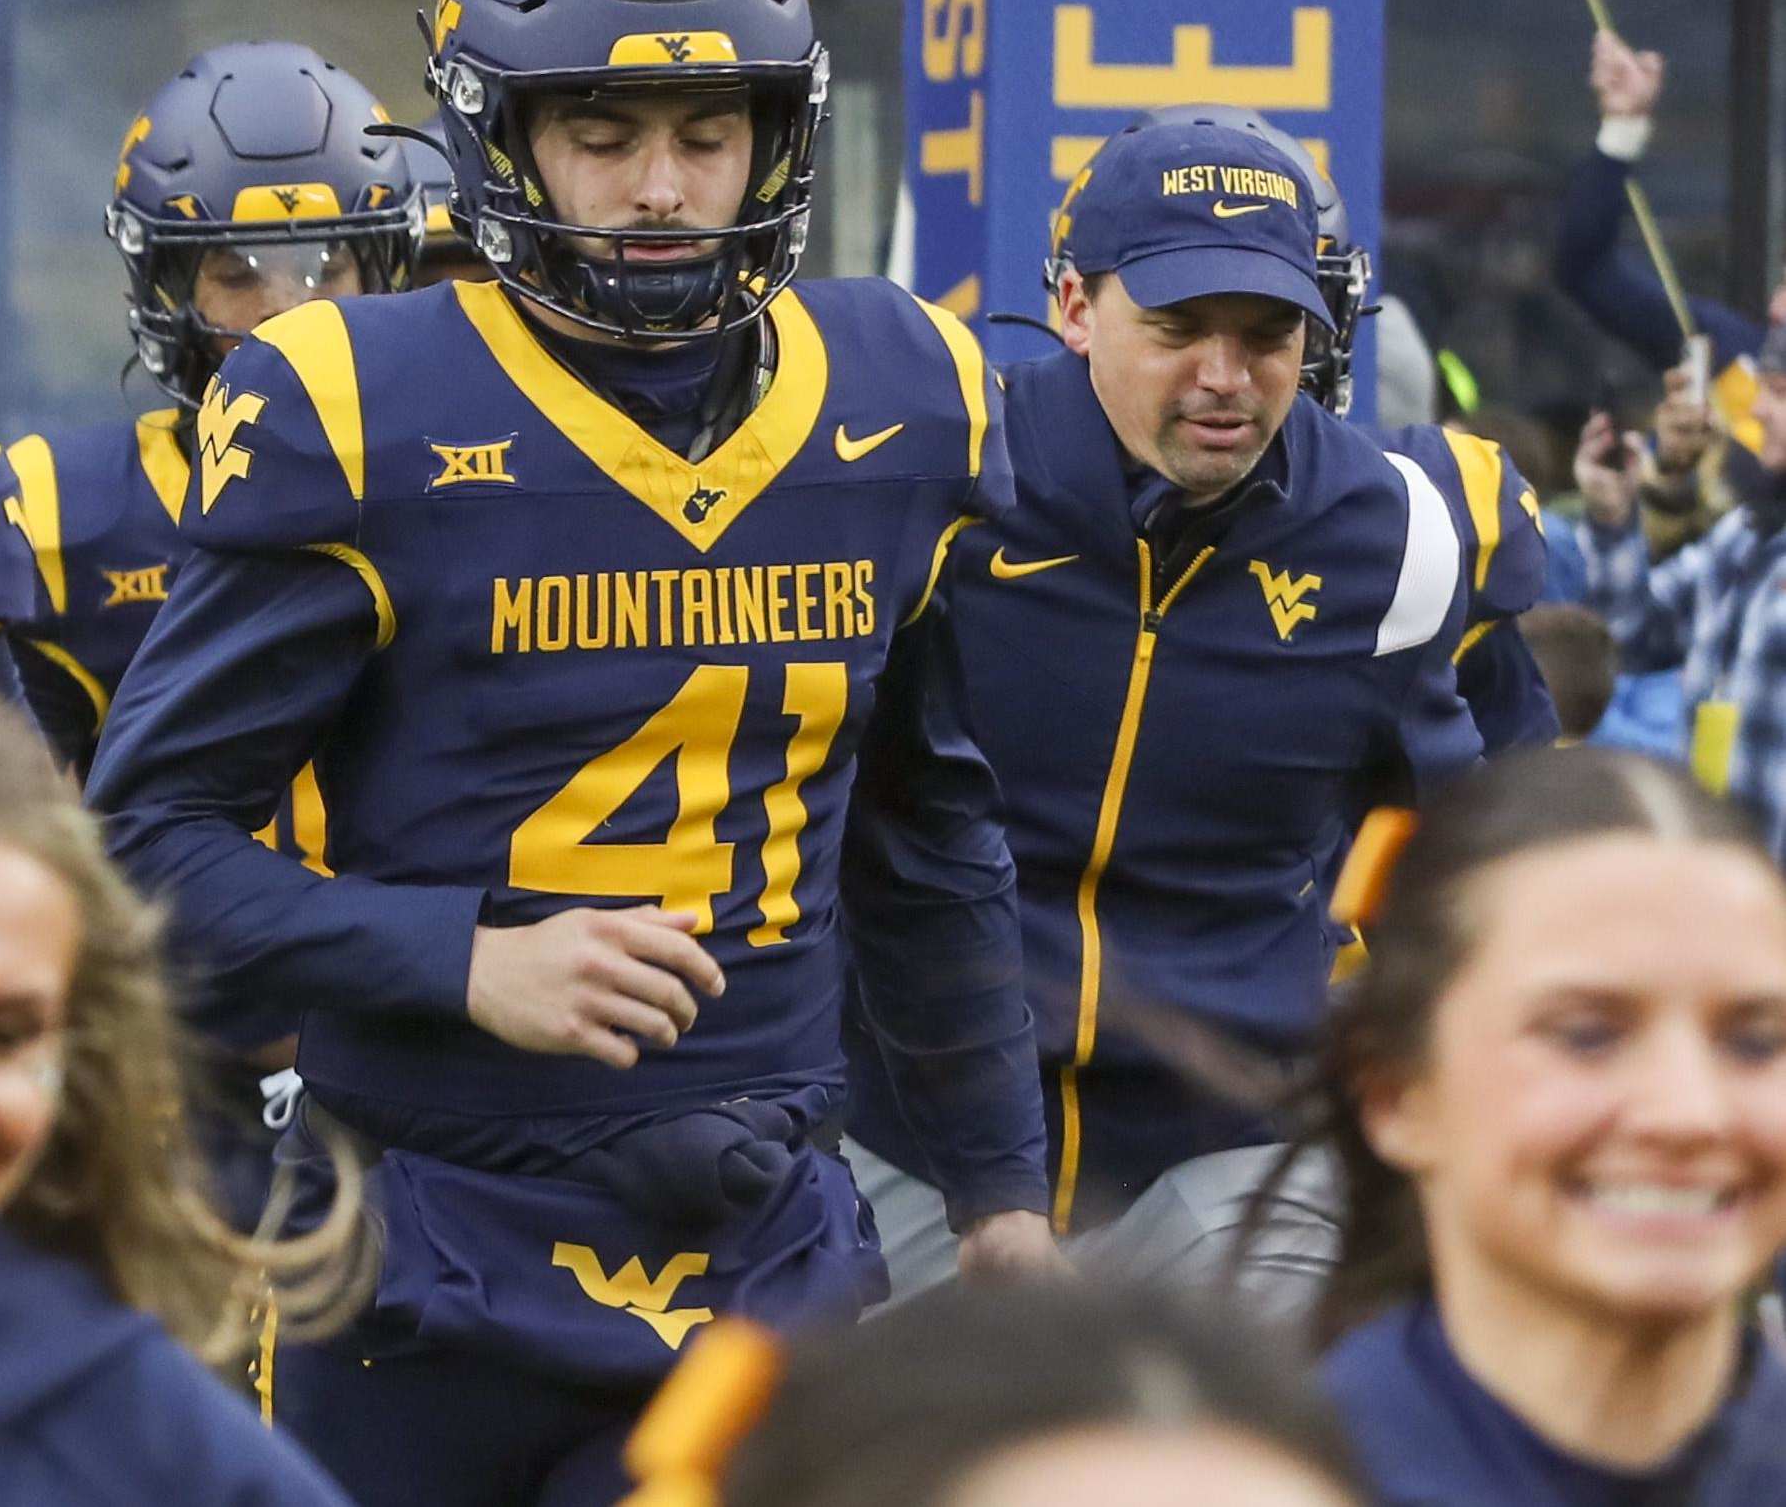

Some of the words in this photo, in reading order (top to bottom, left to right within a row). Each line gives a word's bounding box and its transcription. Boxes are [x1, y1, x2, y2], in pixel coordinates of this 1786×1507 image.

[1163, 165, 1216, 196] WEST
[1219, 165, 1298, 210] VIRGINIA
[491, 559, 875, 655] MOUNTAINEERS
[509, 661, 849, 949] 41
